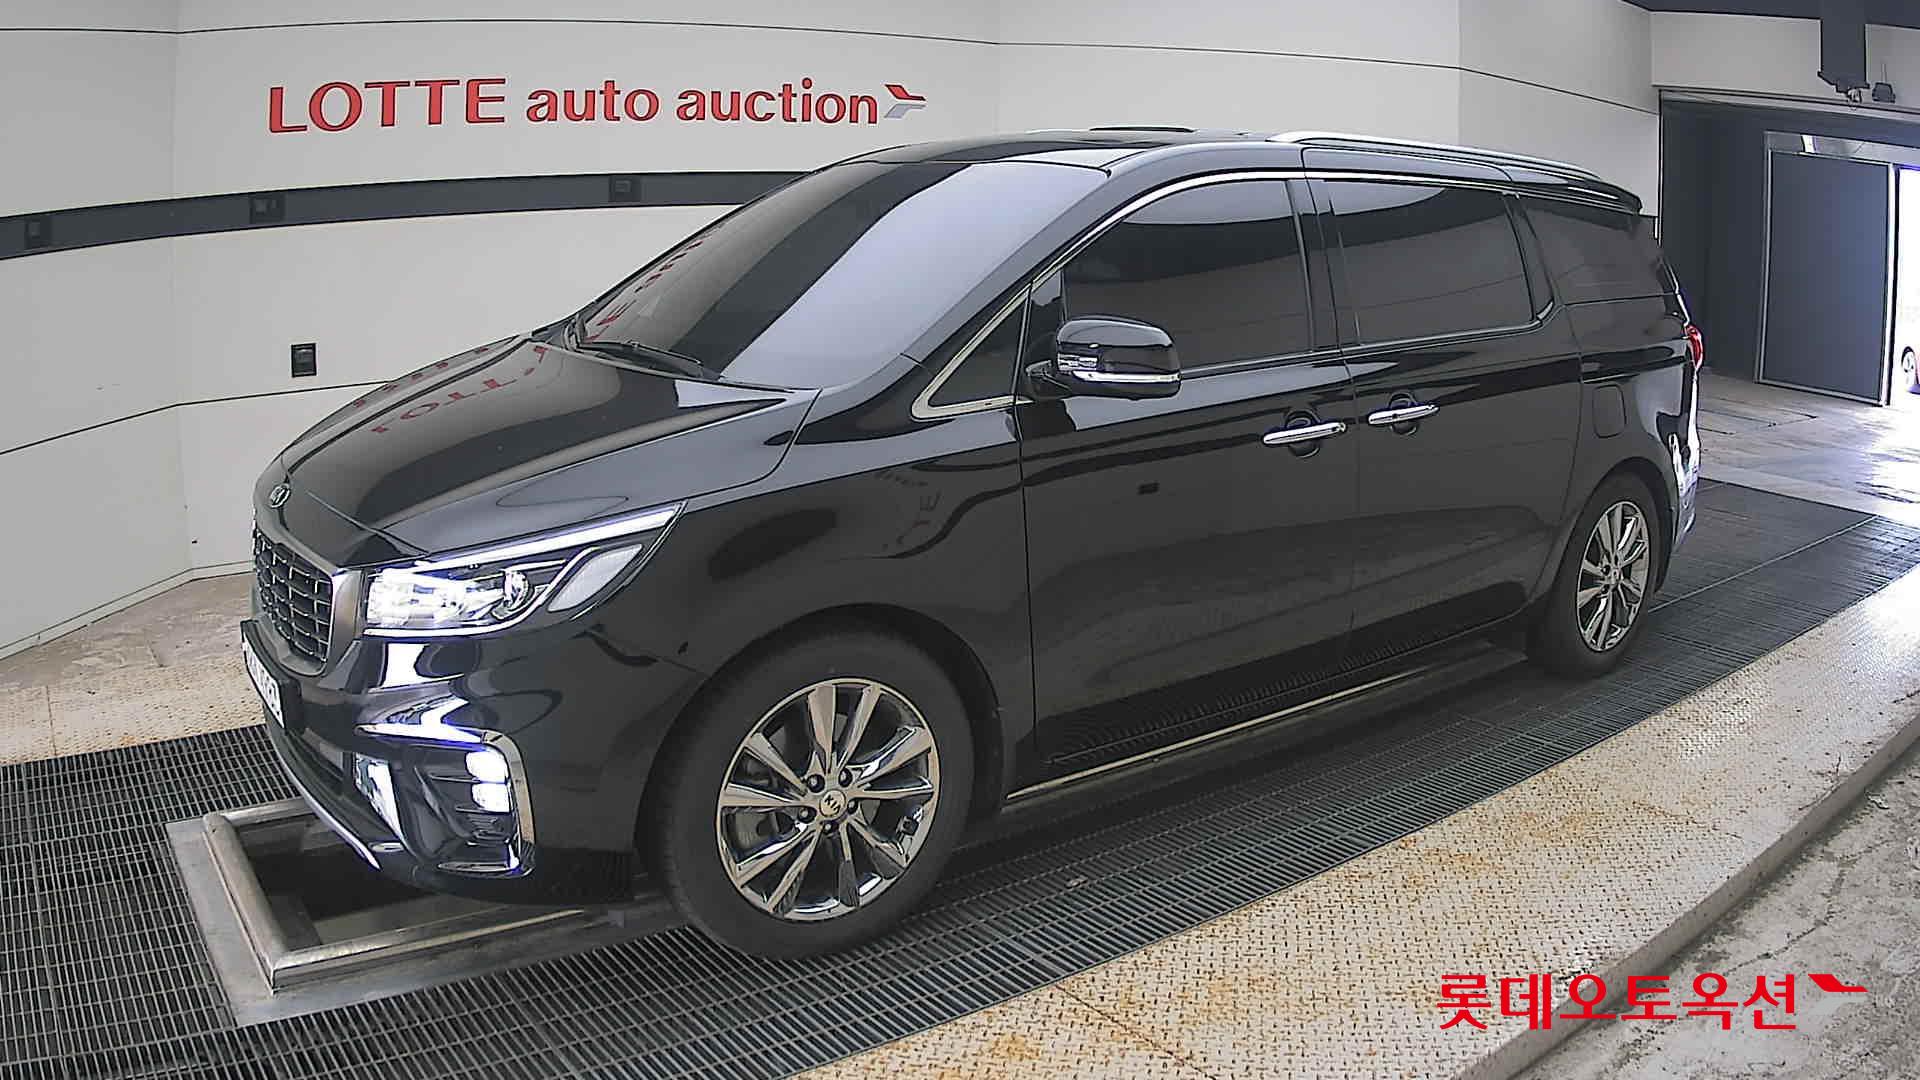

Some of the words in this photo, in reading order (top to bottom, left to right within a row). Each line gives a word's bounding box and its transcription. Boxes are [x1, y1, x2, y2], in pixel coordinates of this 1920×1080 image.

[269, 77, 506, 133] LOTTE
[526, 80, 660, 123] auto
[675, 78, 879, 124] auction
